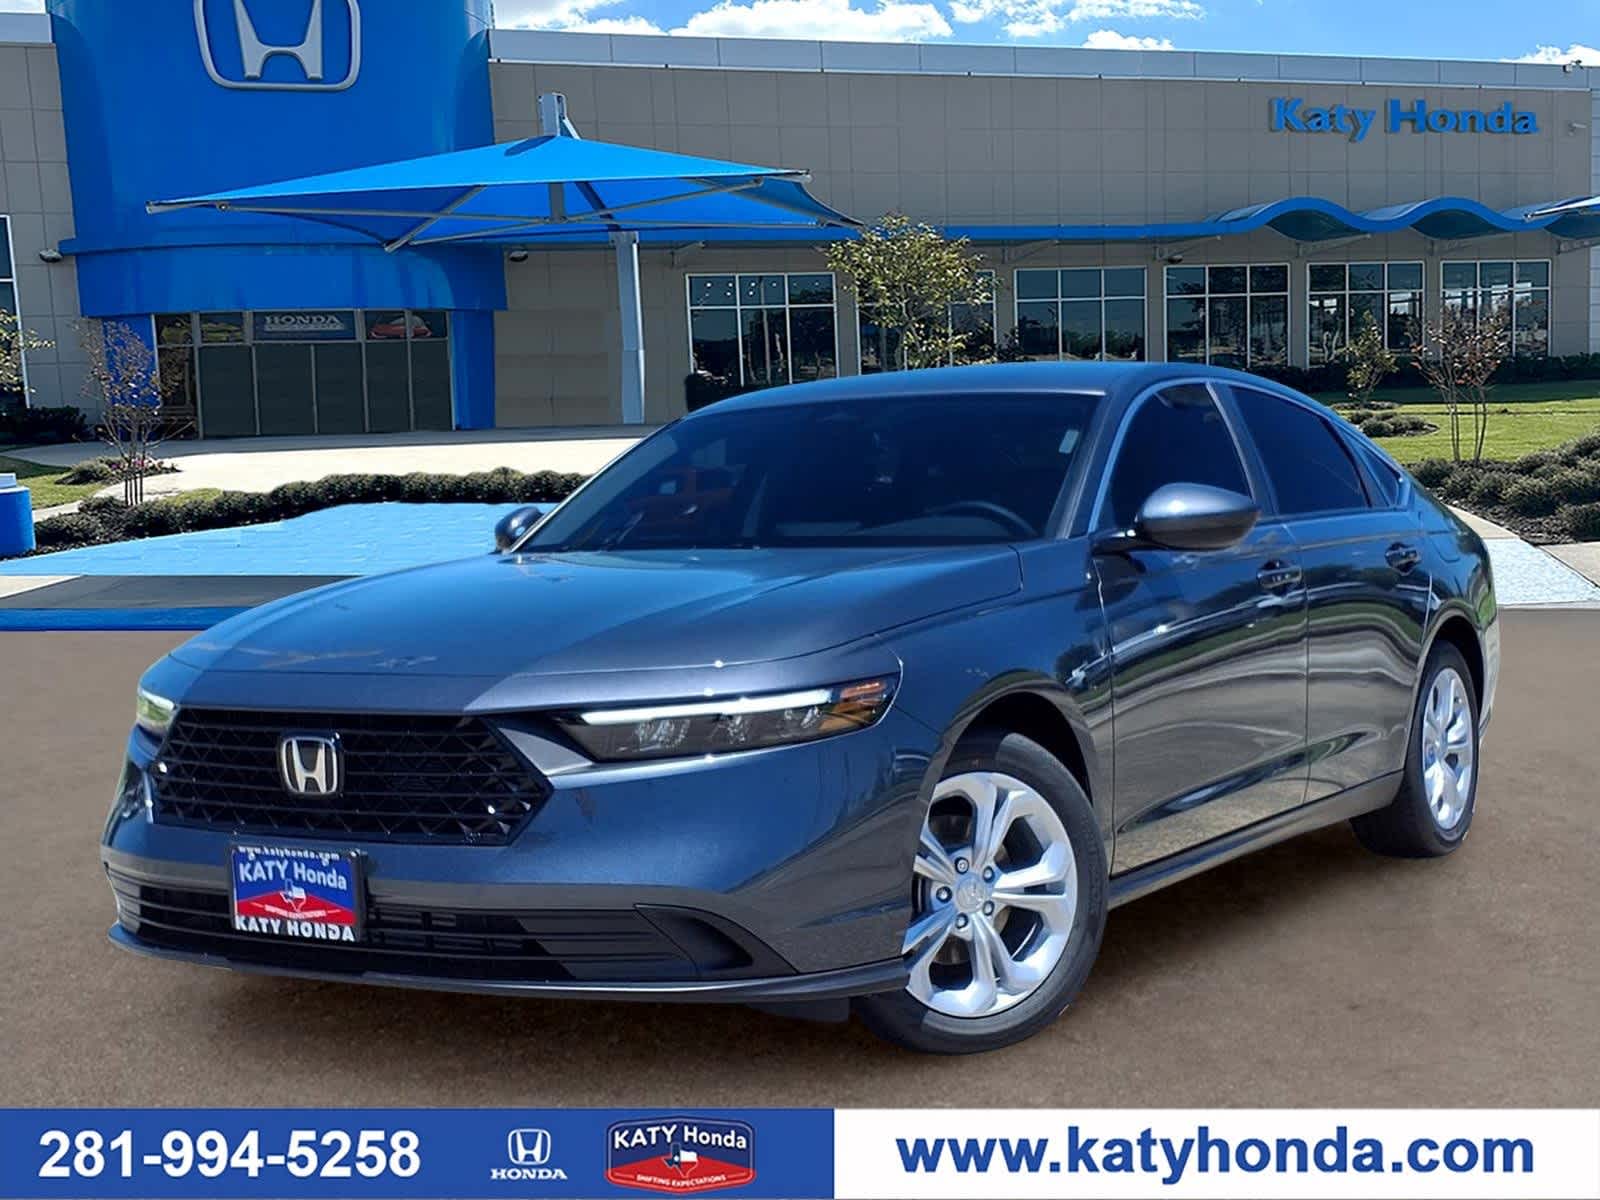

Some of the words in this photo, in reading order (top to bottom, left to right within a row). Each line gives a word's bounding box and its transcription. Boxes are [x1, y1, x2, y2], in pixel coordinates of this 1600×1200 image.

[1269, 97, 1377, 143] Katy
[1386, 98, 1540, 134] Honda
[265, 314, 342, 325] HONDA
[239, 859, 288, 883] KATY
[293, 861, 347, 890] Honda
[235, 915, 281, 934] KATY
[287, 920, 355, 942] HONDA
